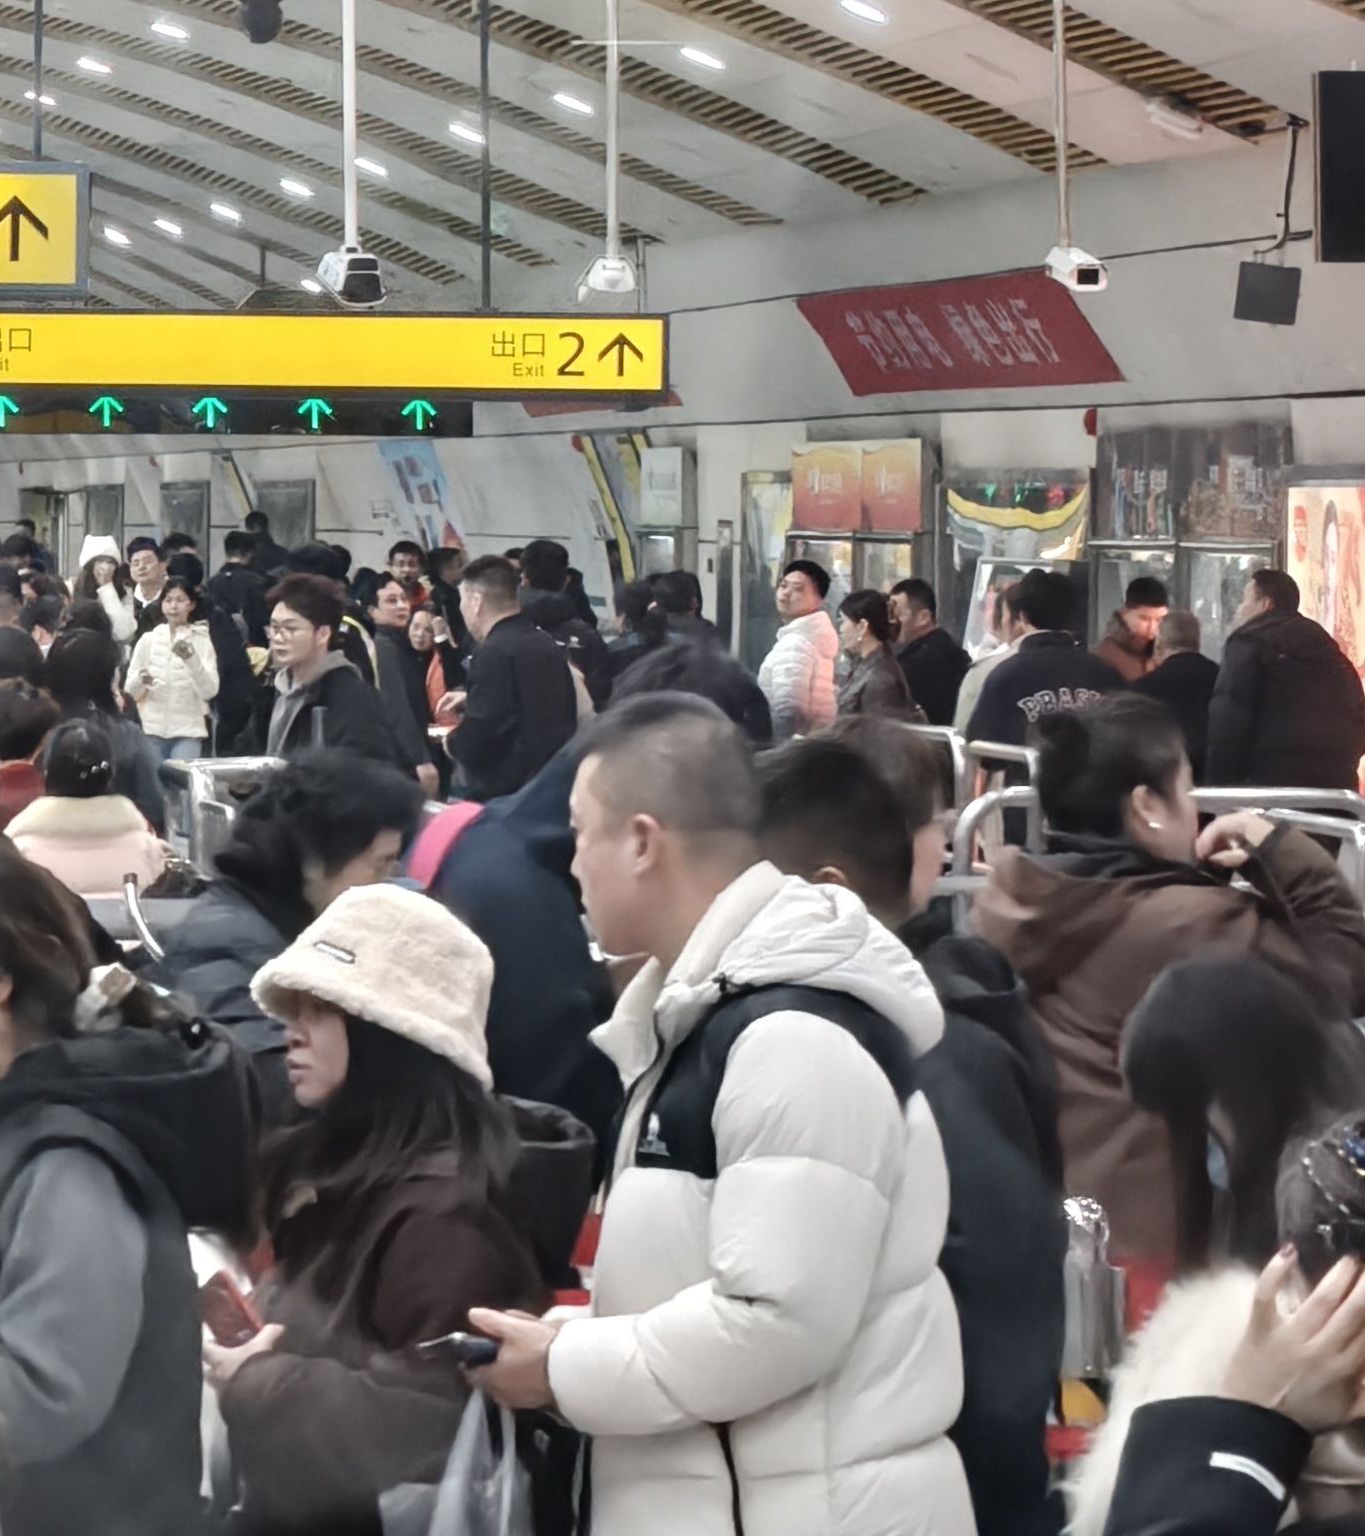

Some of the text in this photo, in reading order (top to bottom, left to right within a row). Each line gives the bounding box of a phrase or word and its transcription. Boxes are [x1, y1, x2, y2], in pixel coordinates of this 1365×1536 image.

[491, 331, 585, 376] 出口 2
[512, 362, 545, 377] Exit
